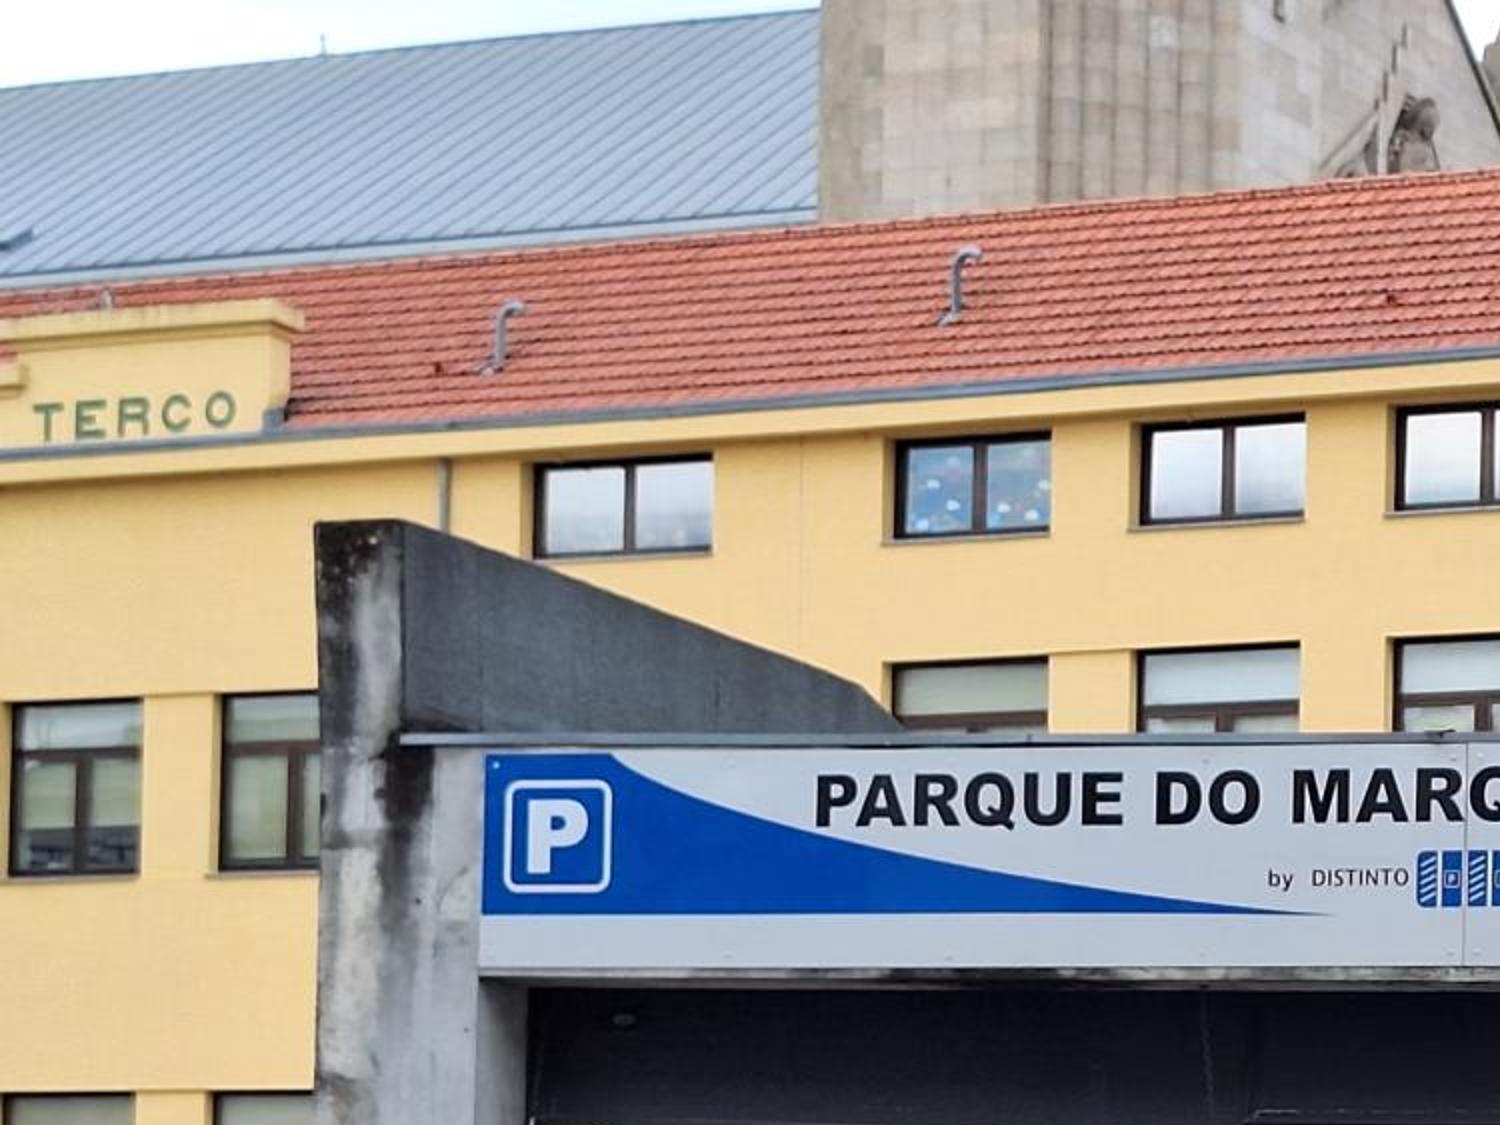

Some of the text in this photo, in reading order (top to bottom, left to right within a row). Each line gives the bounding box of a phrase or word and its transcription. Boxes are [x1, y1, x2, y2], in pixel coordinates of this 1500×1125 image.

[815, 771, 1124, 830] PARQUE
[1155, 769, 1260, 827] DO
[527, 799, 588, 873] P
[1268, 869, 1294, 890] by
[1312, 868, 1409, 887] DISTINTO
